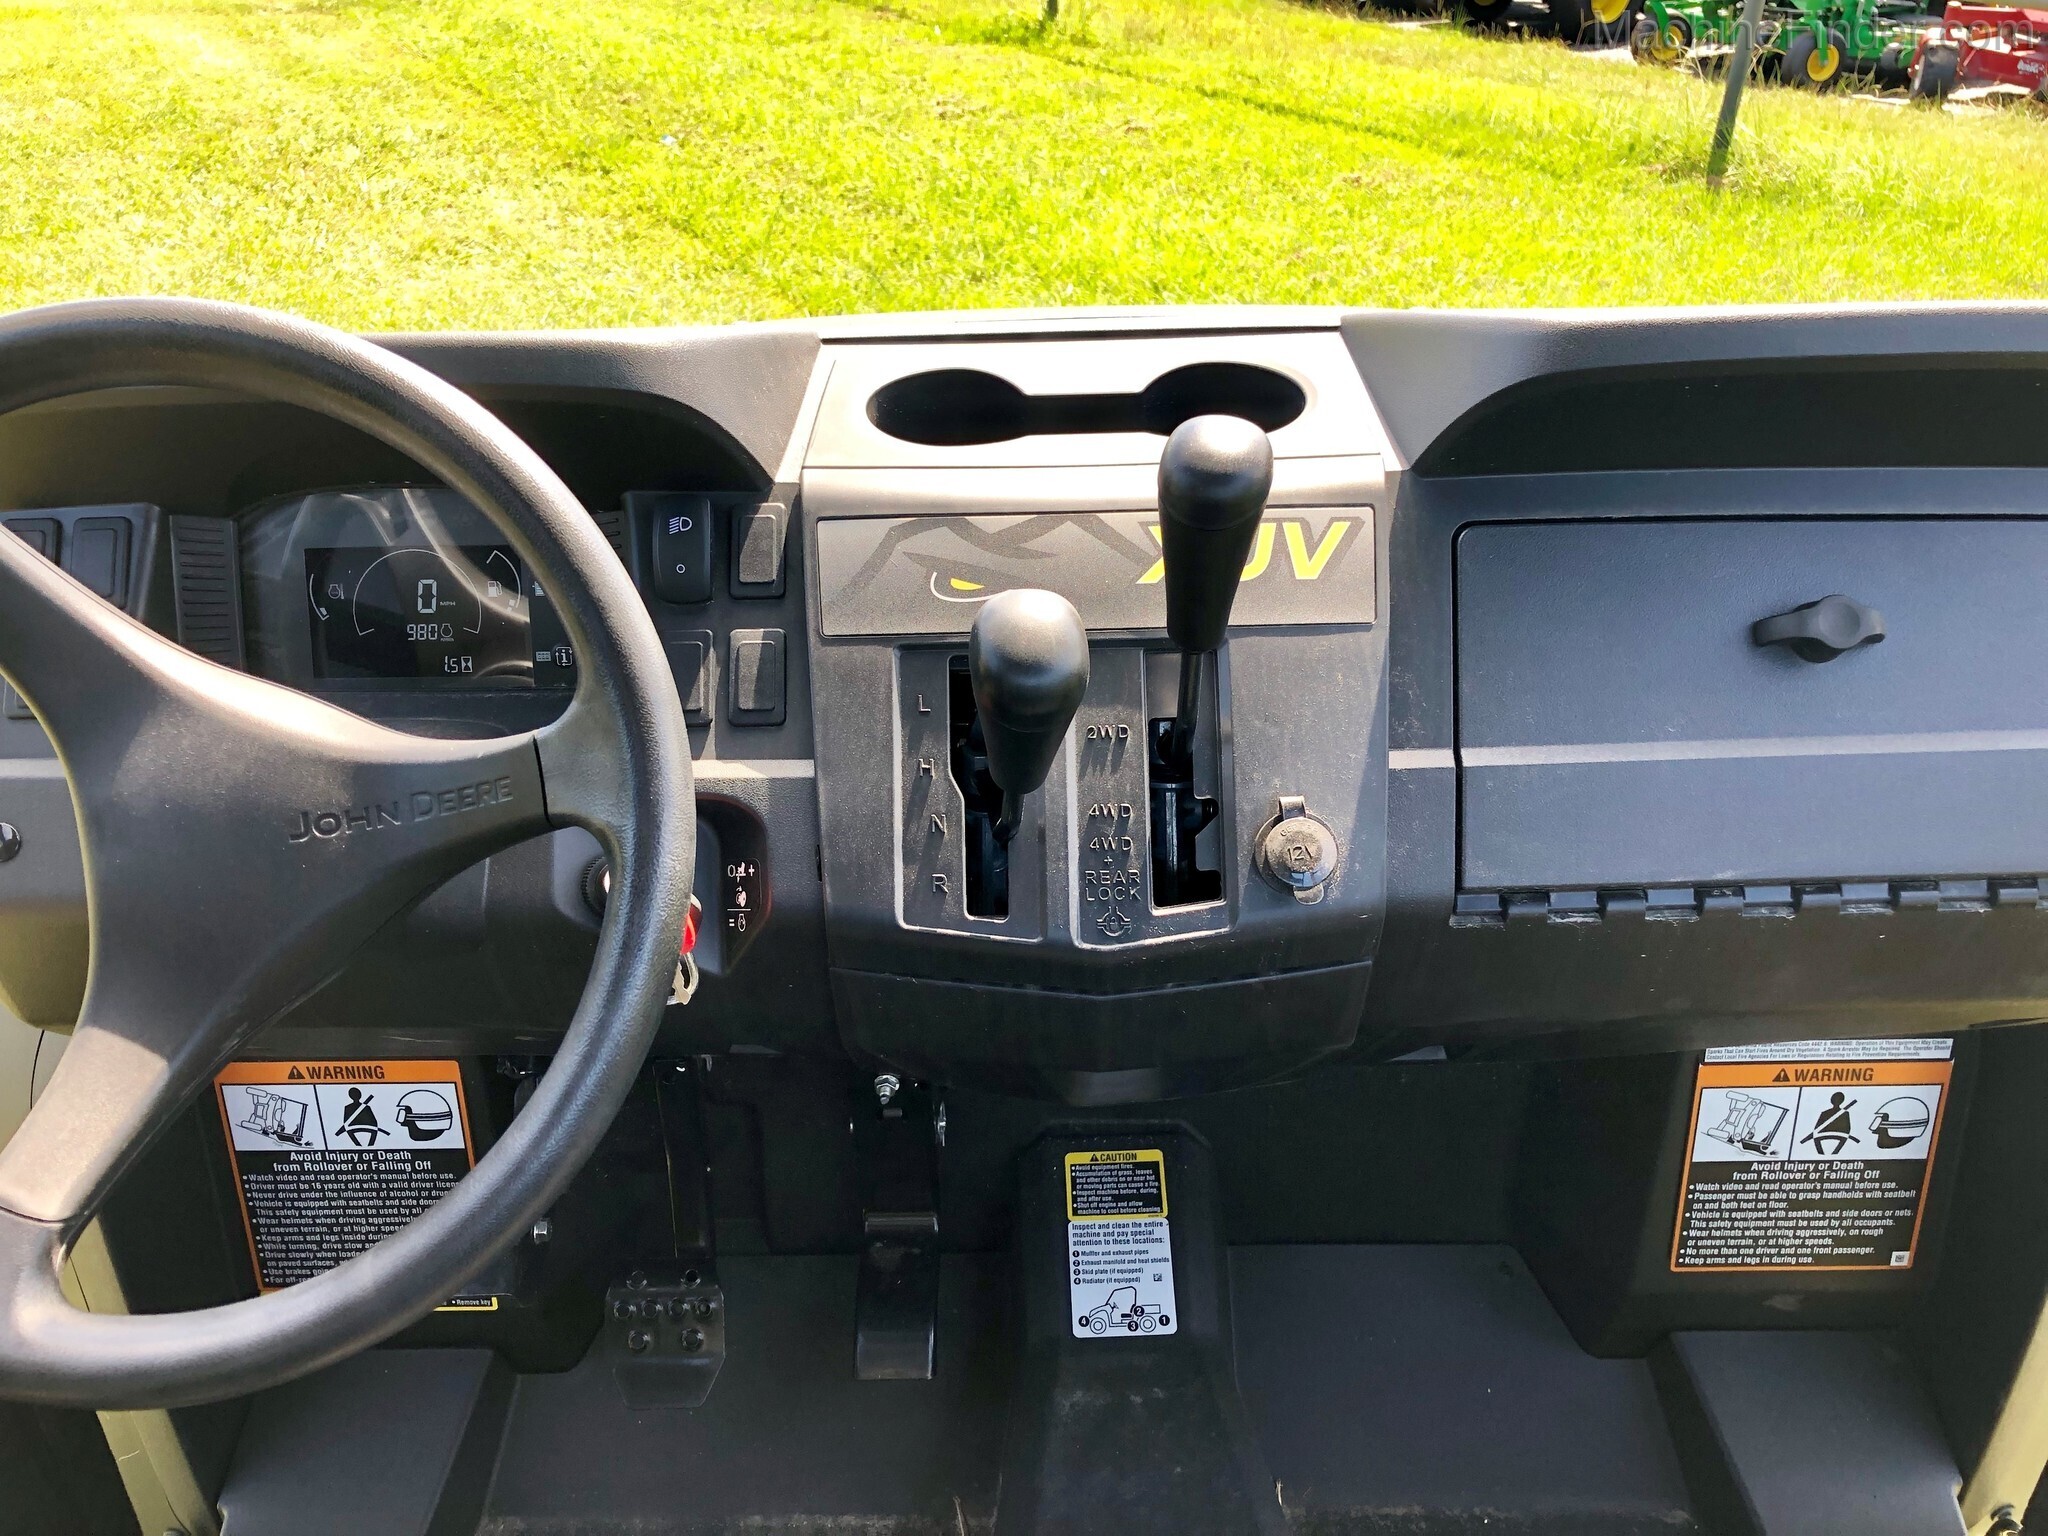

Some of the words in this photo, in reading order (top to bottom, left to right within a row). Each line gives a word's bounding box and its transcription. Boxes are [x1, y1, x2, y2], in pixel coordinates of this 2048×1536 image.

[418, 579, 437, 614] 0
[407, 624, 438, 640] 980
[918, 695, 931, 712] L
[1087, 724, 1130, 739] 2WD
[918, 758, 935, 777] H
[289, 801, 402, 843] JOHN
[411, 776, 514, 822] DEERE
[1089, 803, 1132, 818] 4WD
[931, 814, 947, 833] N
[1089, 836, 1133, 851] 4WD
[1085, 870, 1141, 884] REAR
[932, 874, 949, 893] R
[1085, 886, 1141, 901] LOCK
[306, 1065, 385, 1079] WARNING
[1794, 1068, 1874, 1082] WARNING
[291, 1152, 322, 1161] Avoid
[325, 1152, 358, 1162] Injury
[378, 1151, 412, 1160] Death
[1100, 1153, 1137, 1161] CAUTION
[274, 1163, 301, 1172] from
[304, 1161, 353, 1171] Rollover
[356, 1163, 368, 1171] or
[371, 1161, 412, 1171] Falling
[415, 1161, 431, 1170] Off
[1751, 1162, 1781, 1171] Avoid
[1784, 1162, 1816, 1171] Injury
[1833, 1161, 1864, 1170] Death
[1733, 1172, 1758, 1180] from
[1761, 1171, 1807, 1180] Rollover
[1809, 1172, 1821, 1180] or
[1824, 1170, 1861, 1180] Falling
[1864, 1170, 1880, 1179] Off
[1696, 1183, 1720, 1191] Watch
[1745, 1182, 1760, 1190] and
[1762, 1182, 1780, 1190] read
[1782, 1182, 1822, 1191] operator's
[1855, 1181, 1880, 1189] before
[1694, 1192, 1736, 1201] Passenger
[1737, 1192, 1757, 1200] must
[1758, 1192, 1768, 1200] be
[1799, 1192, 1821, 1200] grasp
[1823, 1191, 1864, 1199] handholds
[1884, 1190, 1916, 1198] seatbelt
[1721, 1201, 1738, 1209] both
[1740, 1201, 1756, 1209] feet
[1769, 1201, 1789, 1209] floor.
[1692, 1211, 1720, 1219] Vehicle
[1731, 1210, 1768, 1219] equipped
[1769, 1210, 1786, 1218] with
[1788, 1210, 1824, 1218] seatbelts
[1072, 1223, 1096, 1231] Inspect
[1691, 1220, 1707, 1228] This
[1708, 1220, 1732, 1228] safety
[1734, 1220, 1776, 1228] equipment
[1777, 1219, 1797, 1227] must
[1798, 1219, 1808, 1227] be
[1810, 1219, 1829, 1227] used
[1830, 1219, 1840, 1228] by
[1854, 1219, 1895, 1227] occupants.
[1130, 1229, 1155, 1238] special
[1689, 1229, 1710, 1237] Wear
[1711, 1229, 1743, 1237] helmets
[1767, 1228, 1794, 1237] driving
[1796, 1228, 1847, 1237] aggressively,
[1861, 1228, 1884, 1236] rough
[1727, 1238, 1756, 1246] terrain,
[1778, 1238, 1803, 1246] higher
[1805, 1238, 1835, 1246] speeds.
[1833, 1247, 1875, 1255] passenger.
[1685, 1257, 1704, 1265] Keep
[1728, 1256, 1742, 1264] and
[1744, 1256, 1761, 1265] legs
[1772, 1256, 1797, 1264] during
